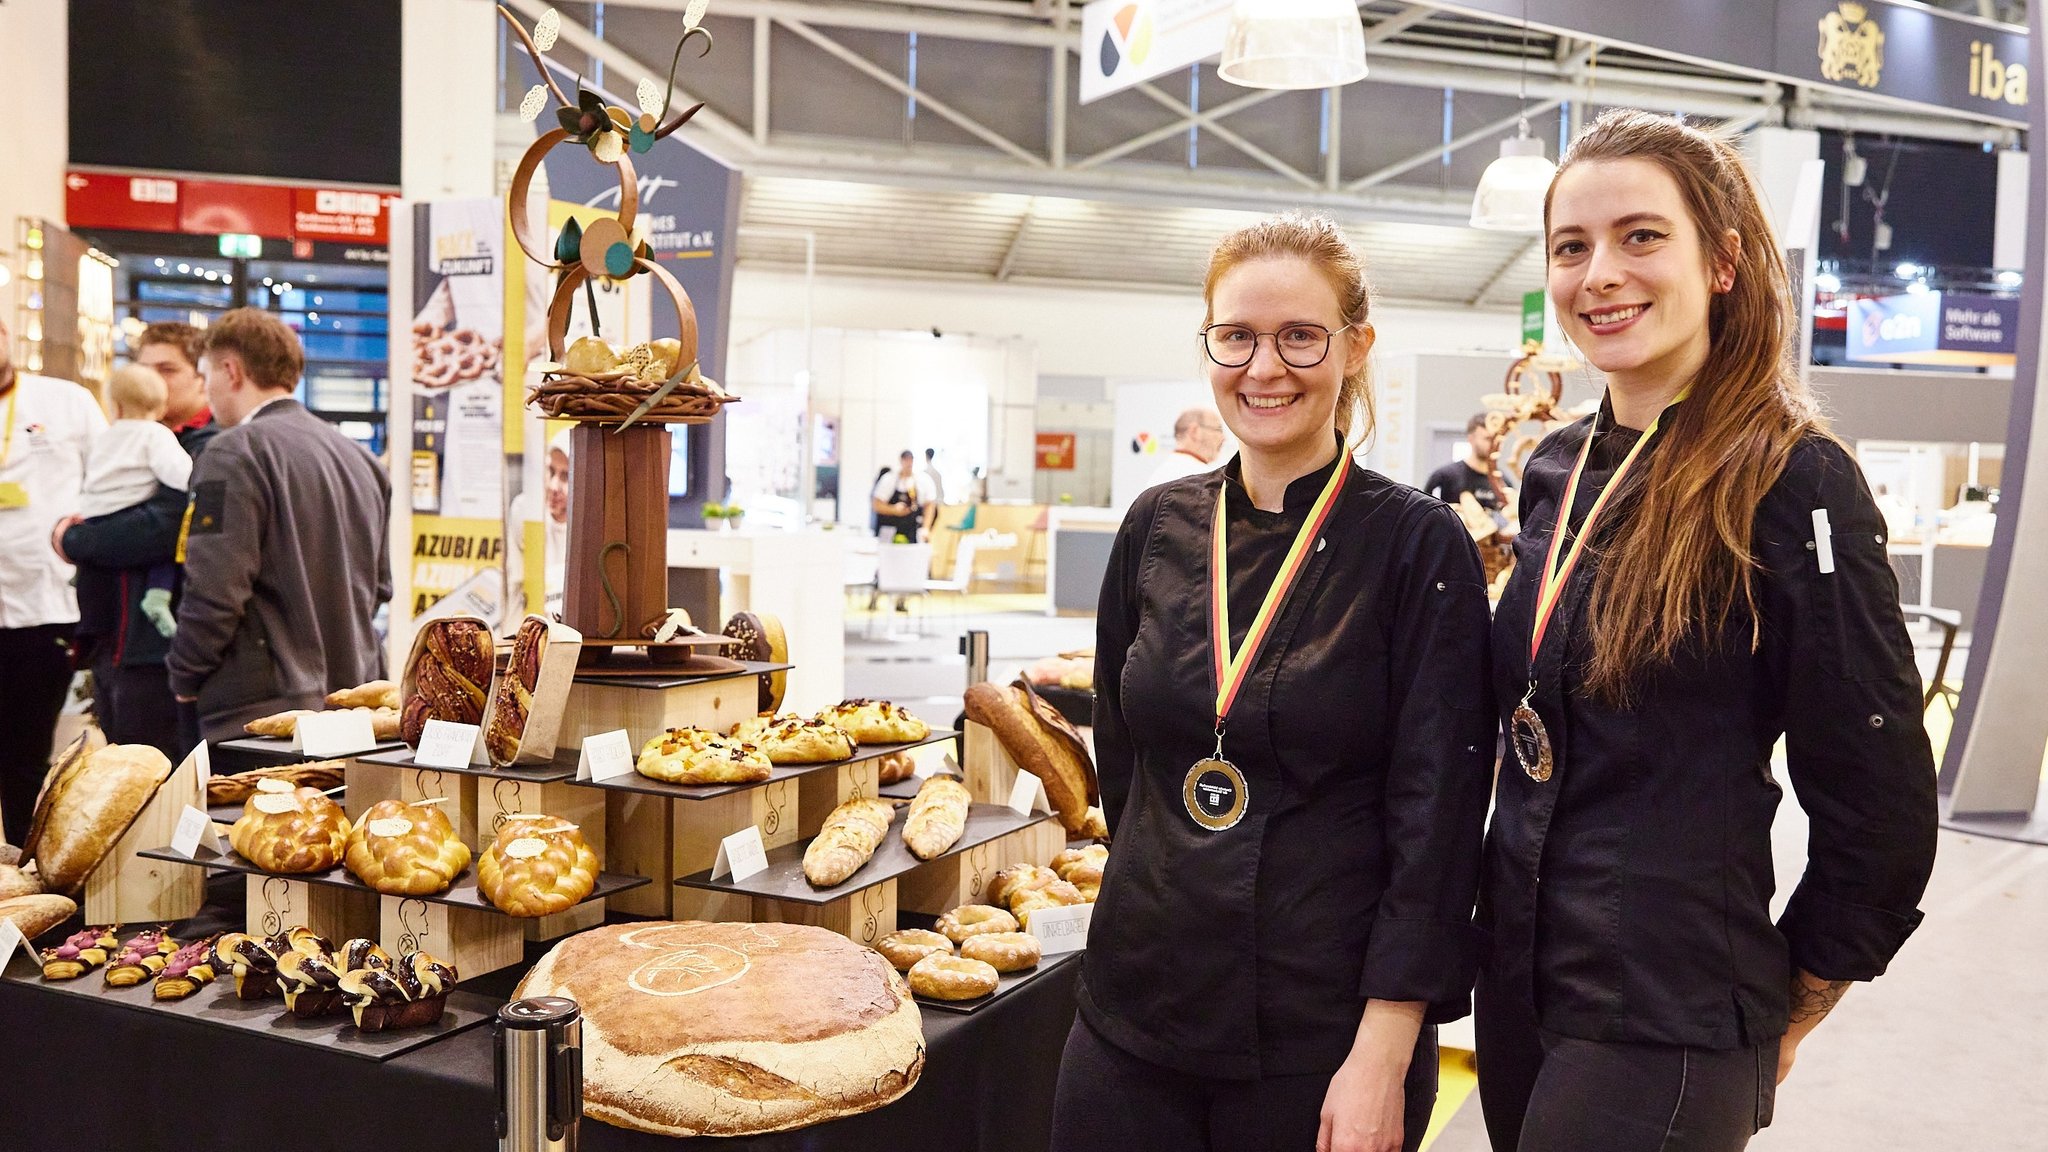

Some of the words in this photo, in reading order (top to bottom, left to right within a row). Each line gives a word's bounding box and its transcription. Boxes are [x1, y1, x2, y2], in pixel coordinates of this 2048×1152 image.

[1945, 308, 1980, 325] Mehr
[1981, 309, 2002, 326] als
[1945, 325, 2003, 342] Software
[414, 533, 474, 559] AZUBI
